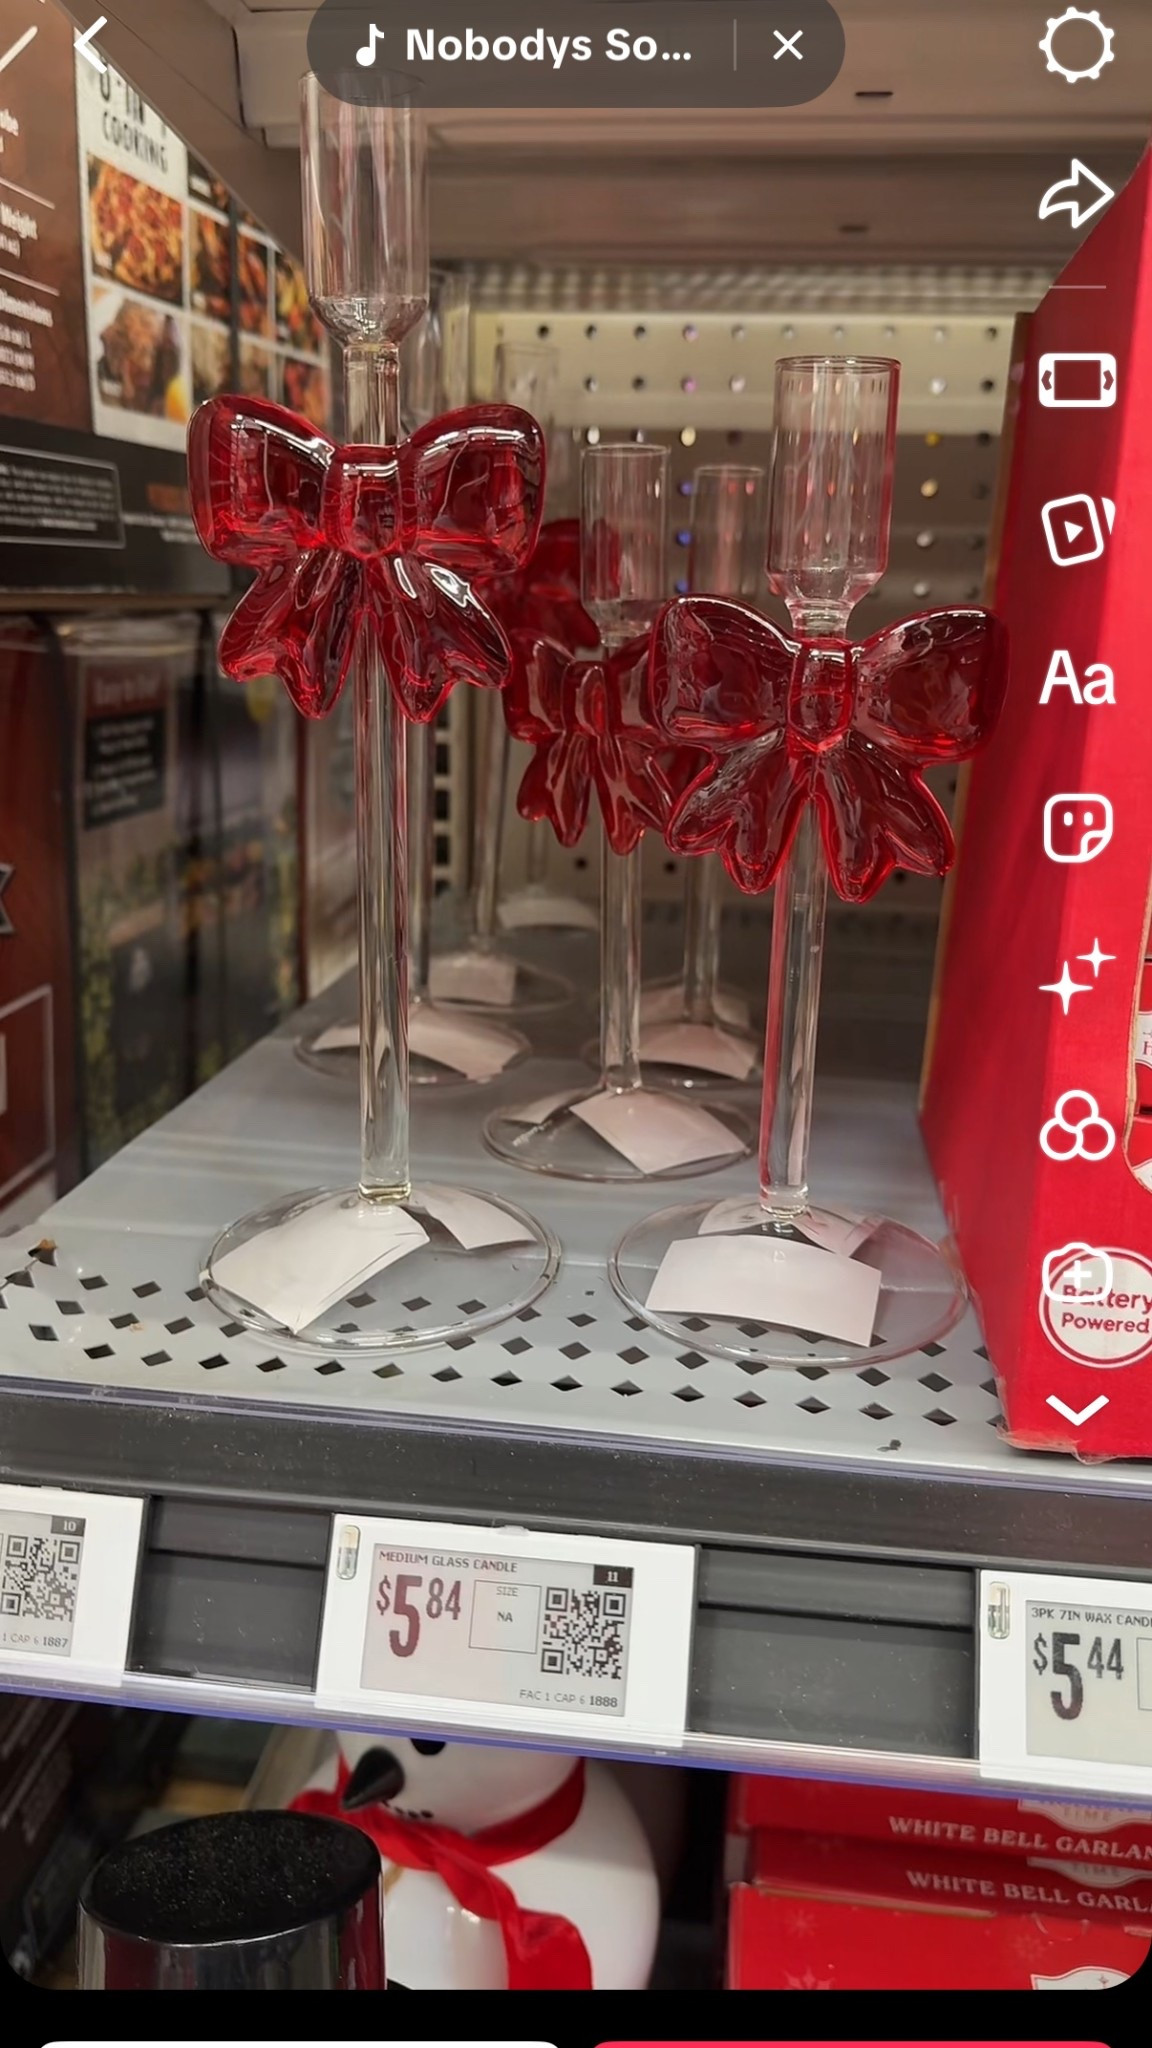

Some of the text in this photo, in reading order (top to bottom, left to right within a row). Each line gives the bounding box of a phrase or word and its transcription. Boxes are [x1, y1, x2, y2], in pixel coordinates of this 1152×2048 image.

[103, 110, 168, 175] COOKING
[1061, 1312, 1150, 1334] Powered
[63, 1521, 76, 1532] 10
[379, 1551, 518, 1573] MEDIUM GLASS CANDLE
[606, 1570, 619, 1583] 11
[496, 1586, 519, 1597] SIZE
[497, 1611, 513, 1623] NA
[1031, 1607, 1055, 1620] 3PK
[1060, 1609, 1081, 1621] 7IN
[1085, 1612, 1112, 1624] WAX
[10, 1632, 30, 1644] CAP
[43, 1635, 69, 1648] 1887
[519, 1689, 542, 1701] FAC
[554, 1692, 576, 1704] CAP
[589, 1695, 618, 1708] 1888
[888, 1815, 976, 1843] WHITE
[983, 1826, 1048, 1849] BELL
[906, 1869, 1152, 1914] WHITE BELL GARL
